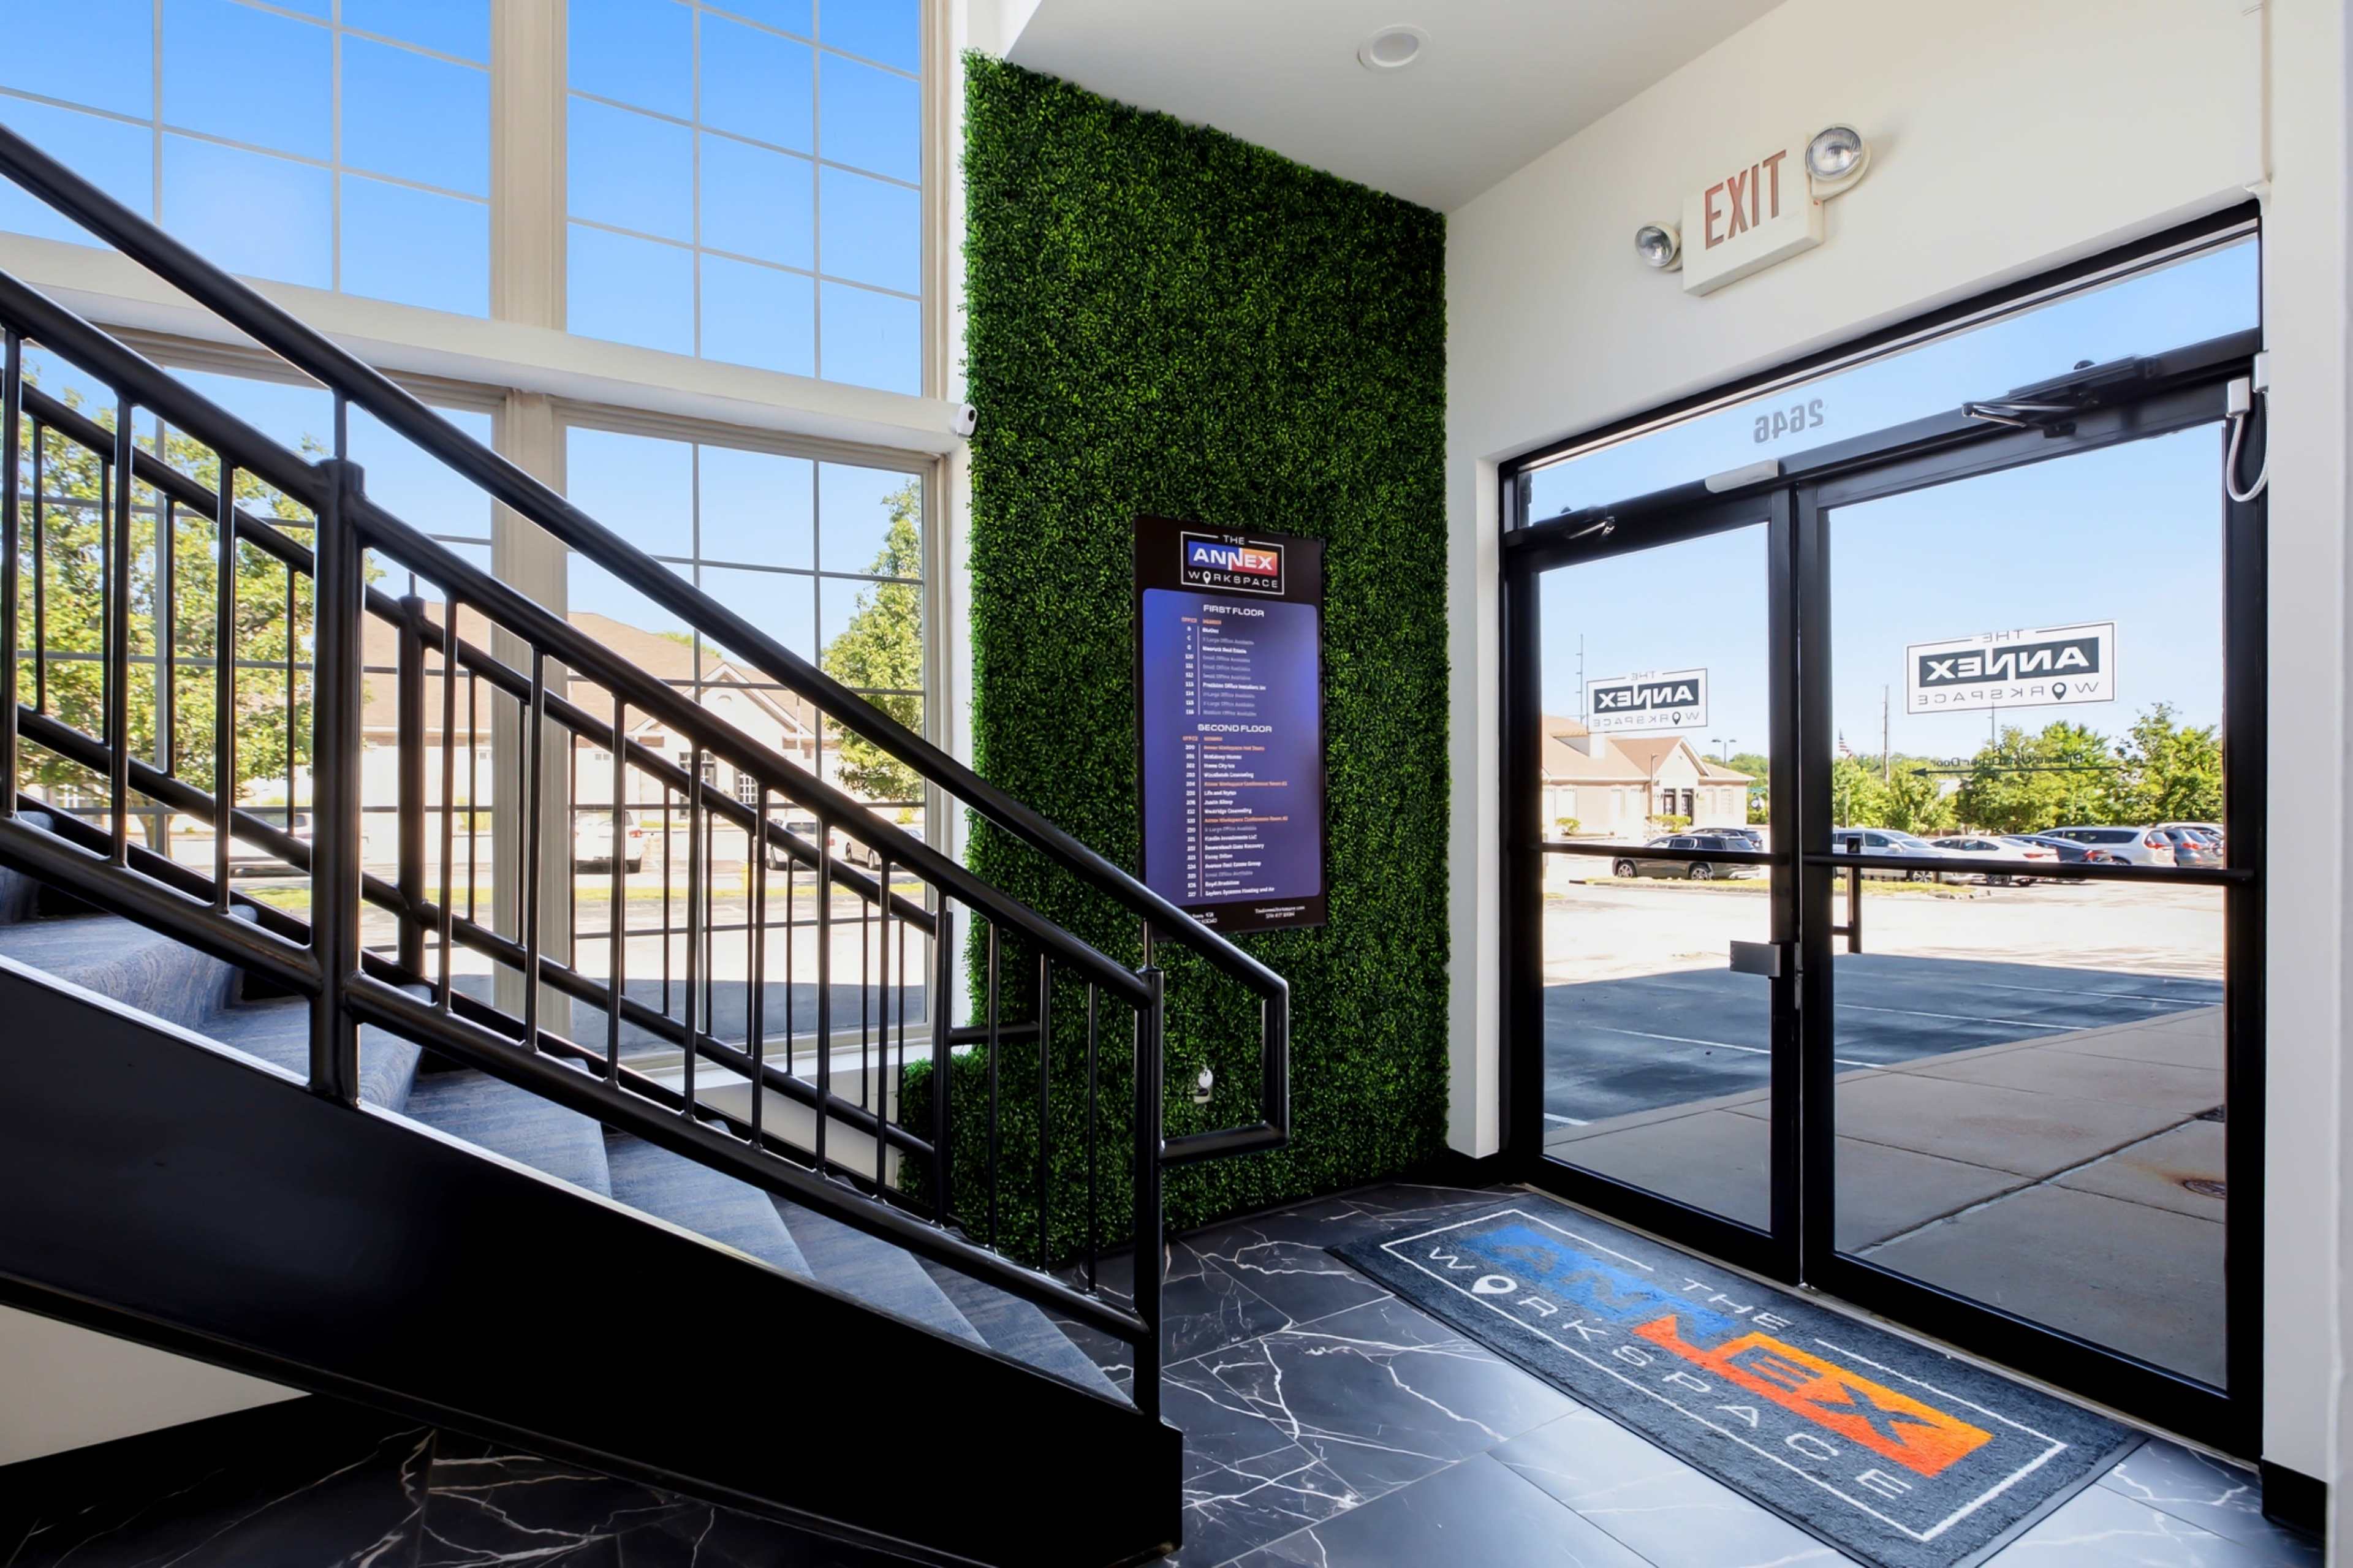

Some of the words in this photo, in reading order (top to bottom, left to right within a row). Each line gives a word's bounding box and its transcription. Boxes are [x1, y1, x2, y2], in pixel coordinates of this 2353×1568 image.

[1705, 149, 1787, 251] EXIT
[1223, 534, 1245, 545] THE
[1193, 548, 1273, 570] ANNEX
[1188, 570, 1278, 589] WORKSPACE
[1203, 604, 1231, 615] FIRST
[1232, 607, 1264, 618] FLOOR
[1683, 1277, 1793, 1330] THE
[1493, 1241, 1942, 1449] ANNEX
